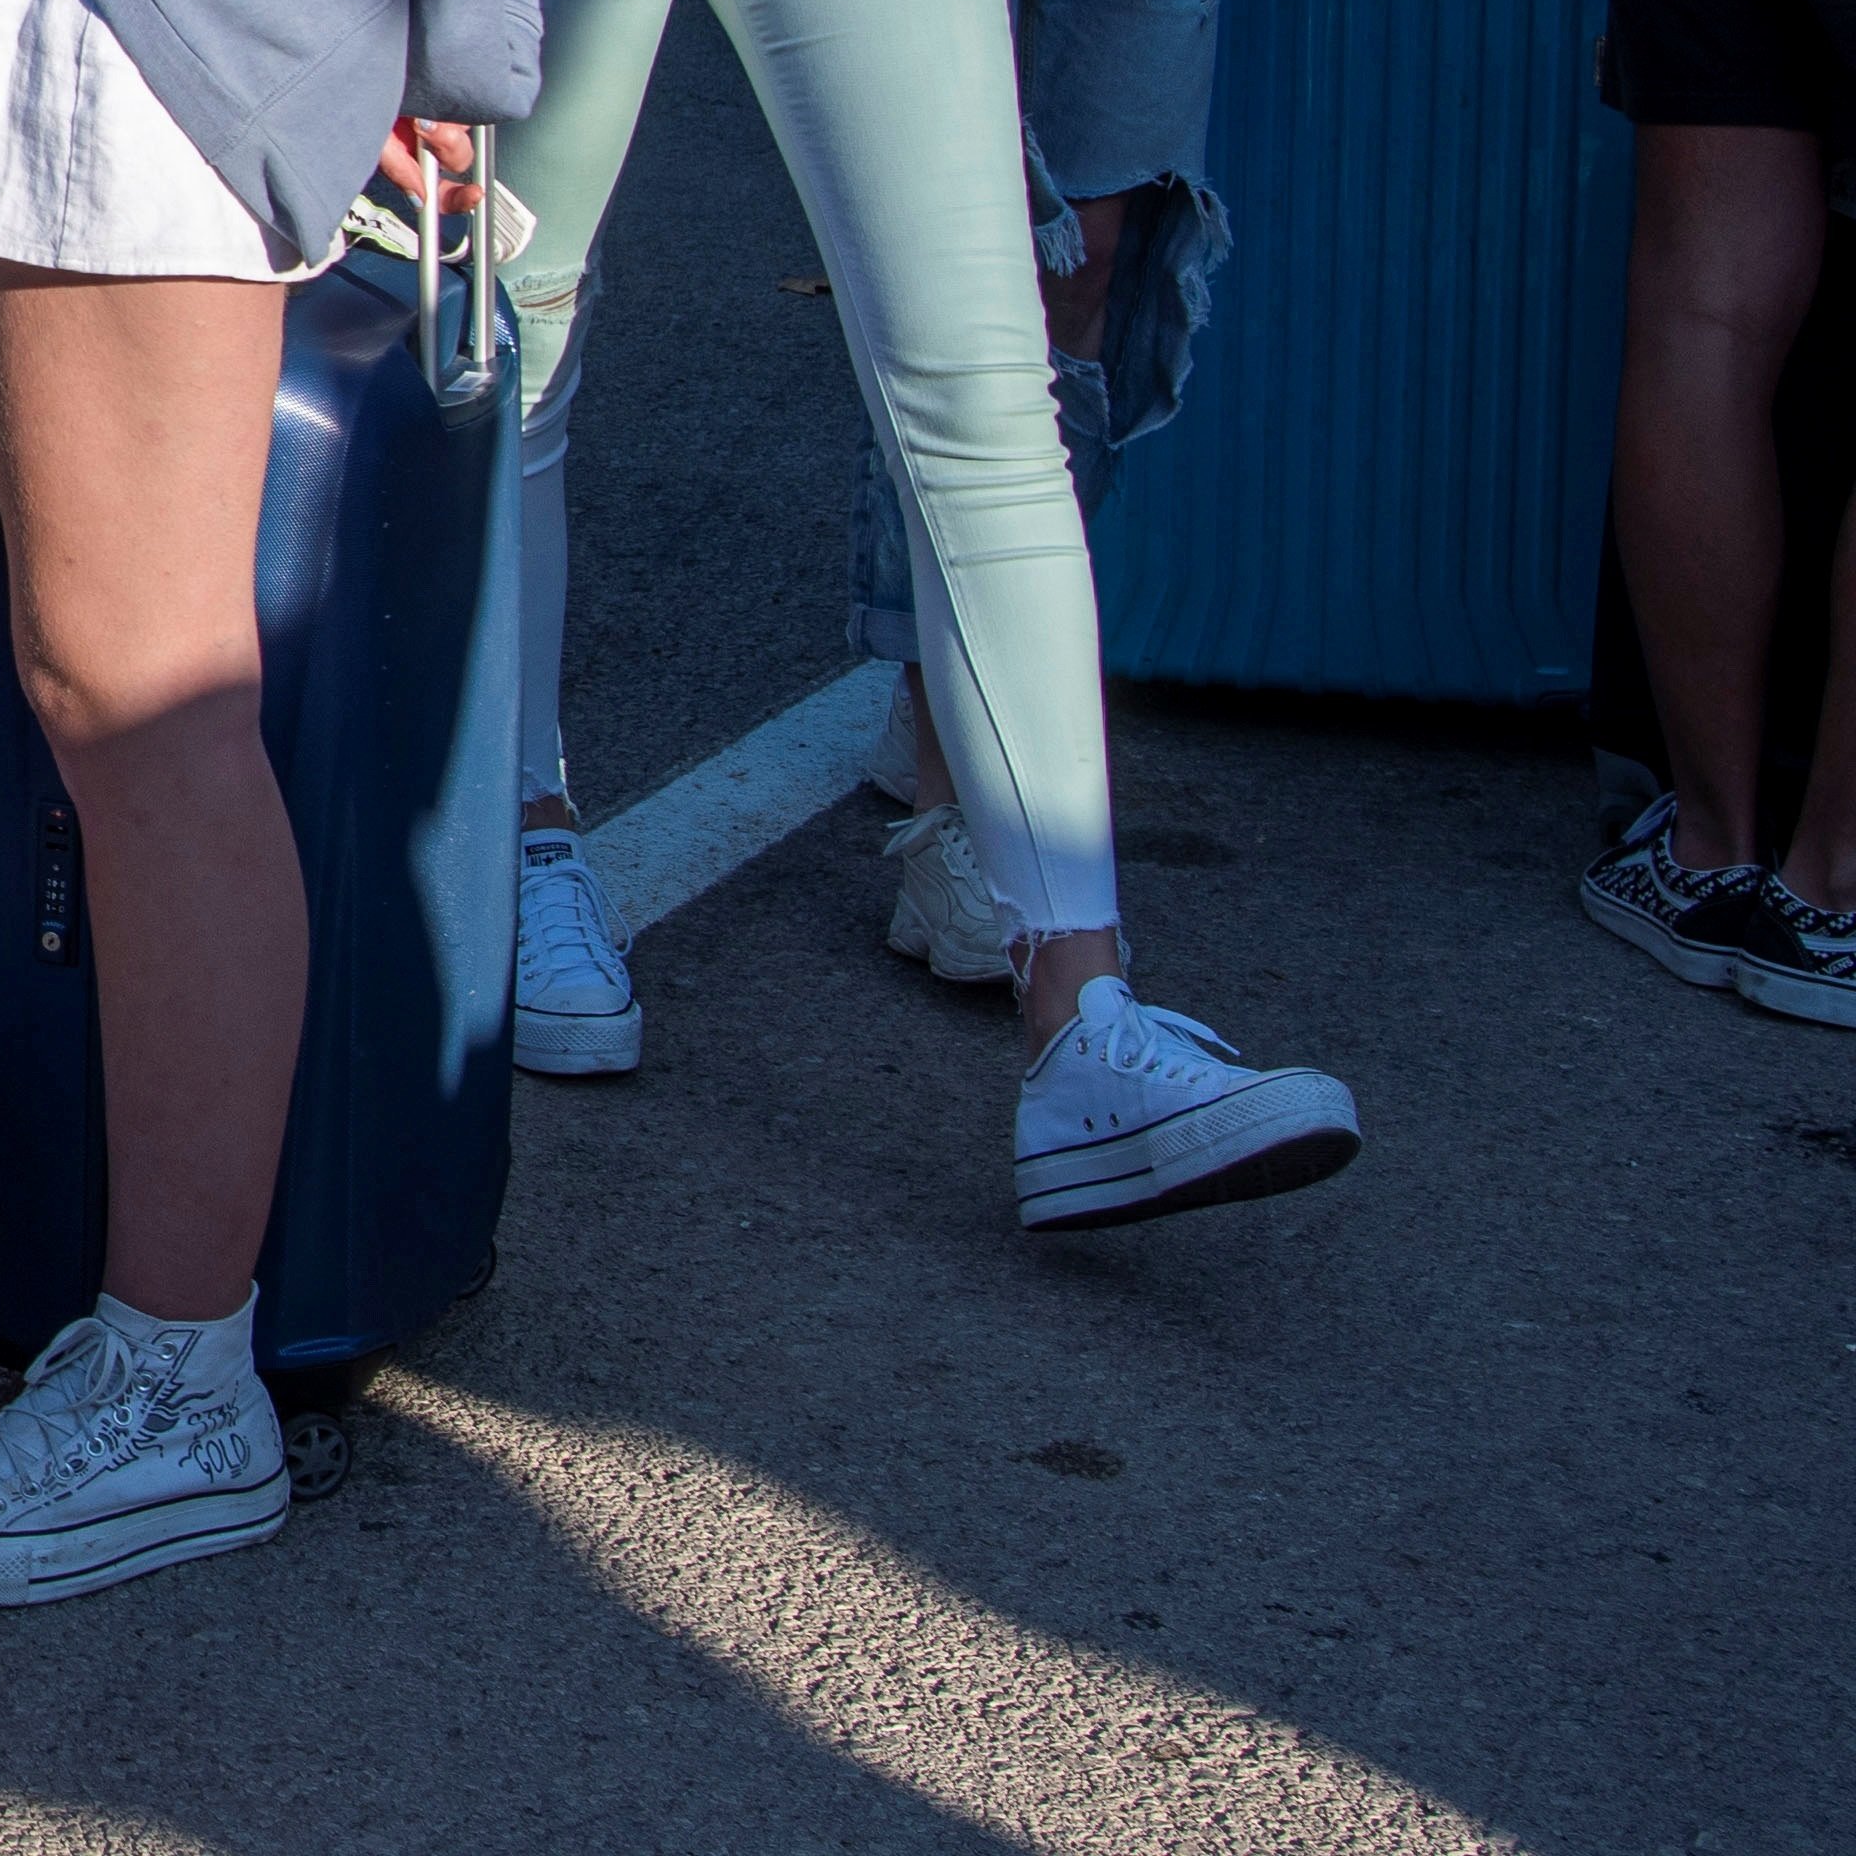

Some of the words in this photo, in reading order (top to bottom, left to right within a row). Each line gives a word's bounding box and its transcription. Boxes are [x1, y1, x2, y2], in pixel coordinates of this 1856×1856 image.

[1716, 867, 1749, 886] VANS
[1821, 956, 1856, 977] VANS
[193, 1433, 247, 1483] GOLD
